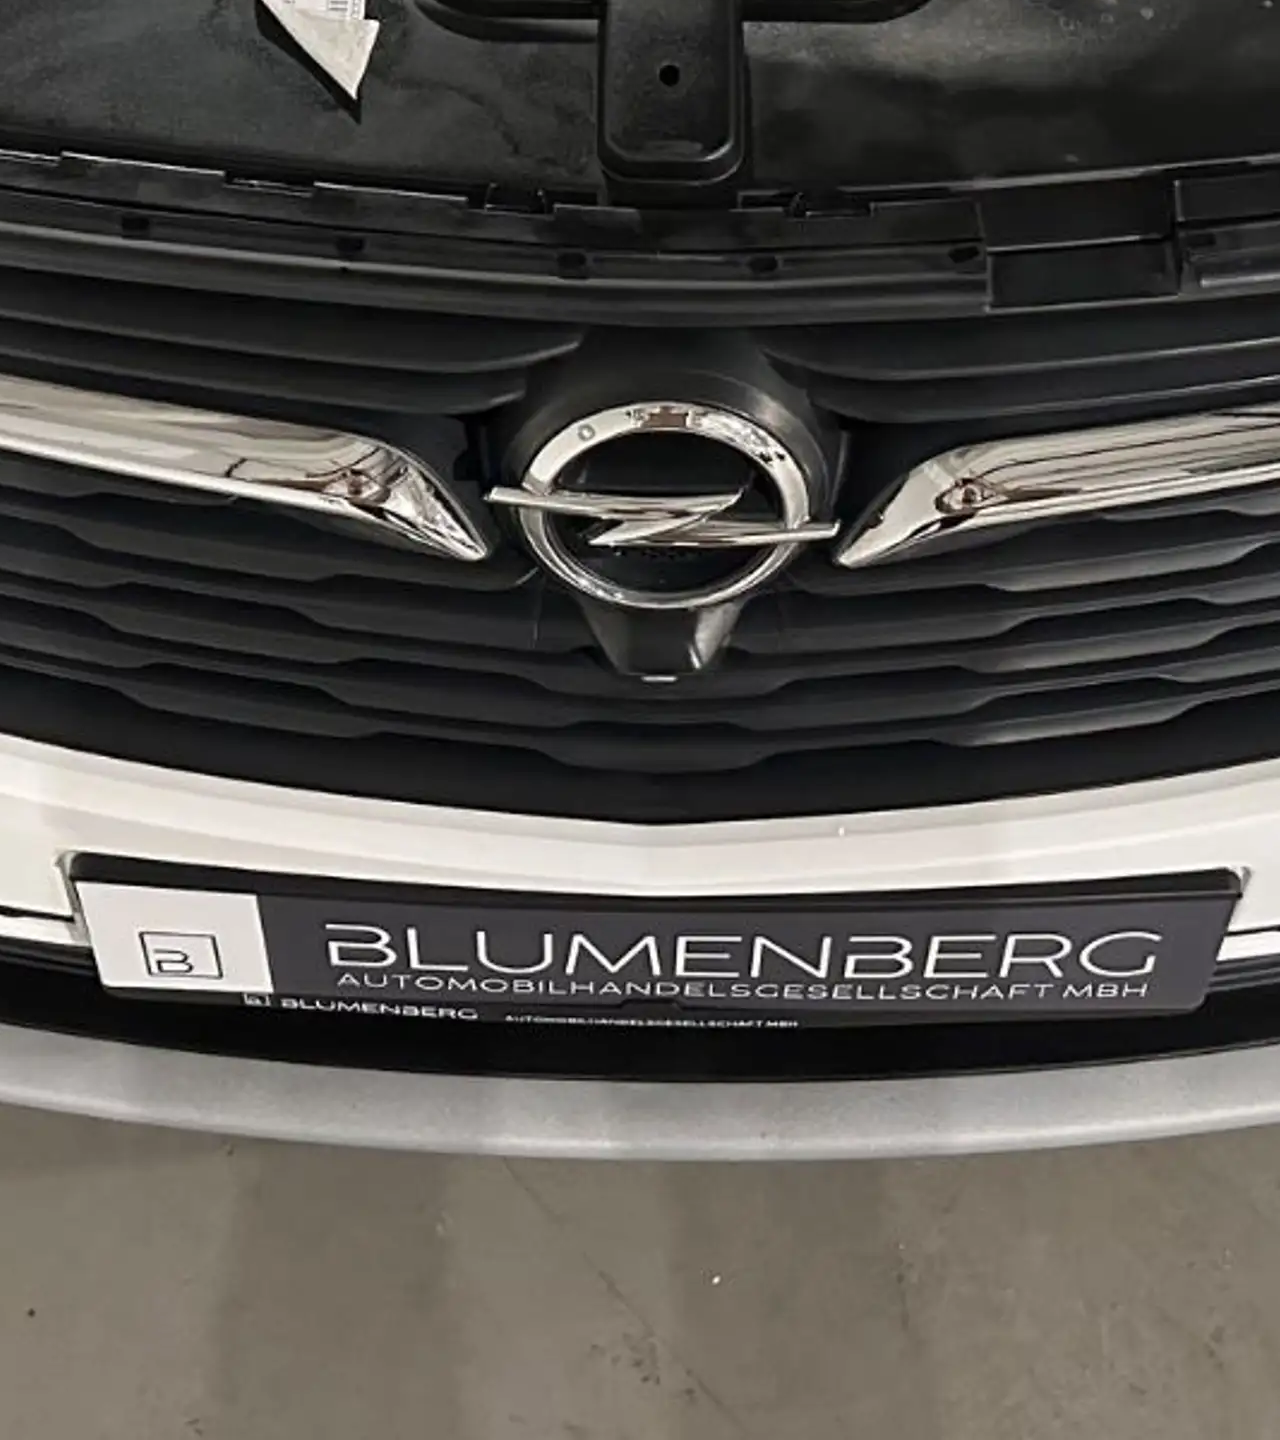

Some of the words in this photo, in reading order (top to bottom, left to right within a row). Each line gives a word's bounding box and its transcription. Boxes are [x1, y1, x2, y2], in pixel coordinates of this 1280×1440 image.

[324, 923, 1163, 980] BLUMENBERG
[337, 972, 1054, 1000] AUTOMOBILHANDELSGESELLSCHAFT
[1062, 982, 1149, 999] MBH
[280, 997, 479, 1020] BLUMENBERG
